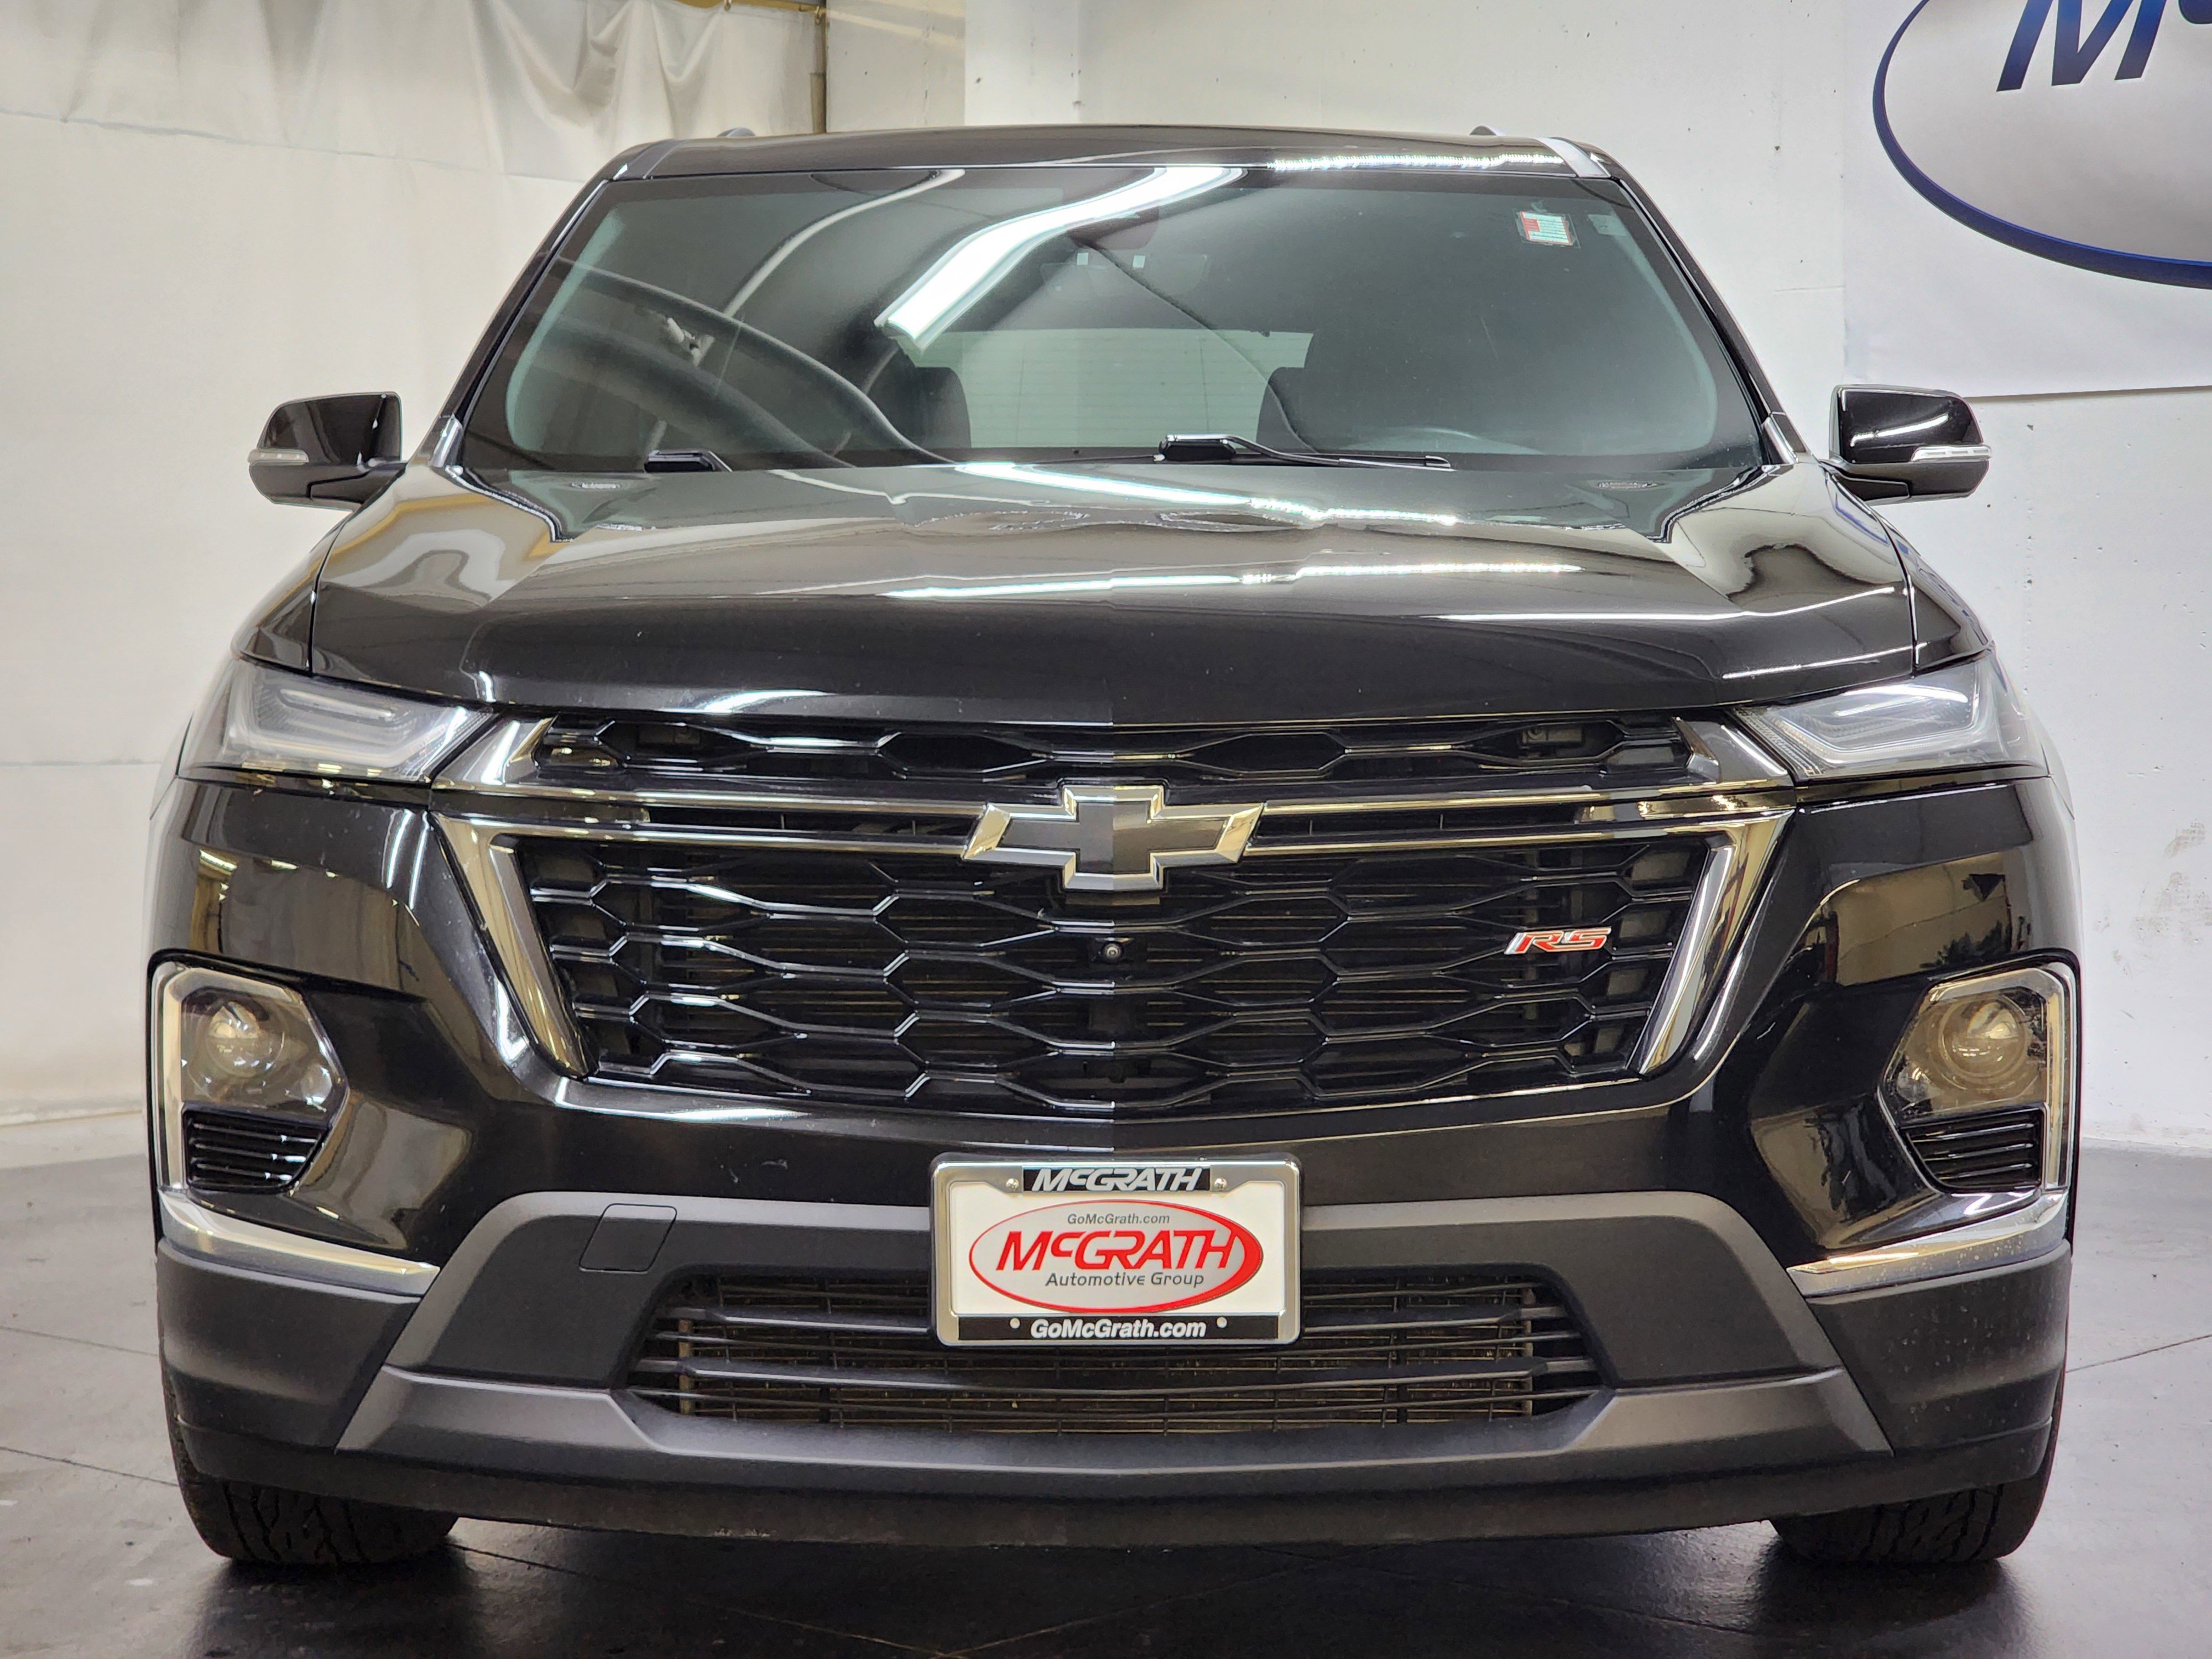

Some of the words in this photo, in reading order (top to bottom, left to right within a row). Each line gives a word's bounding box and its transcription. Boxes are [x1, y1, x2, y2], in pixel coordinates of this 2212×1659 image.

[1504, 926, 1611, 955] RS
[1067, 1213, 1170, 1225] GoMcGrath.com
[1045, 1272, 1145, 1286] Automotive
[1151, 1272, 1204, 1288] Group
[1030, 1318, 1207, 1339] GoMcGrath.com
